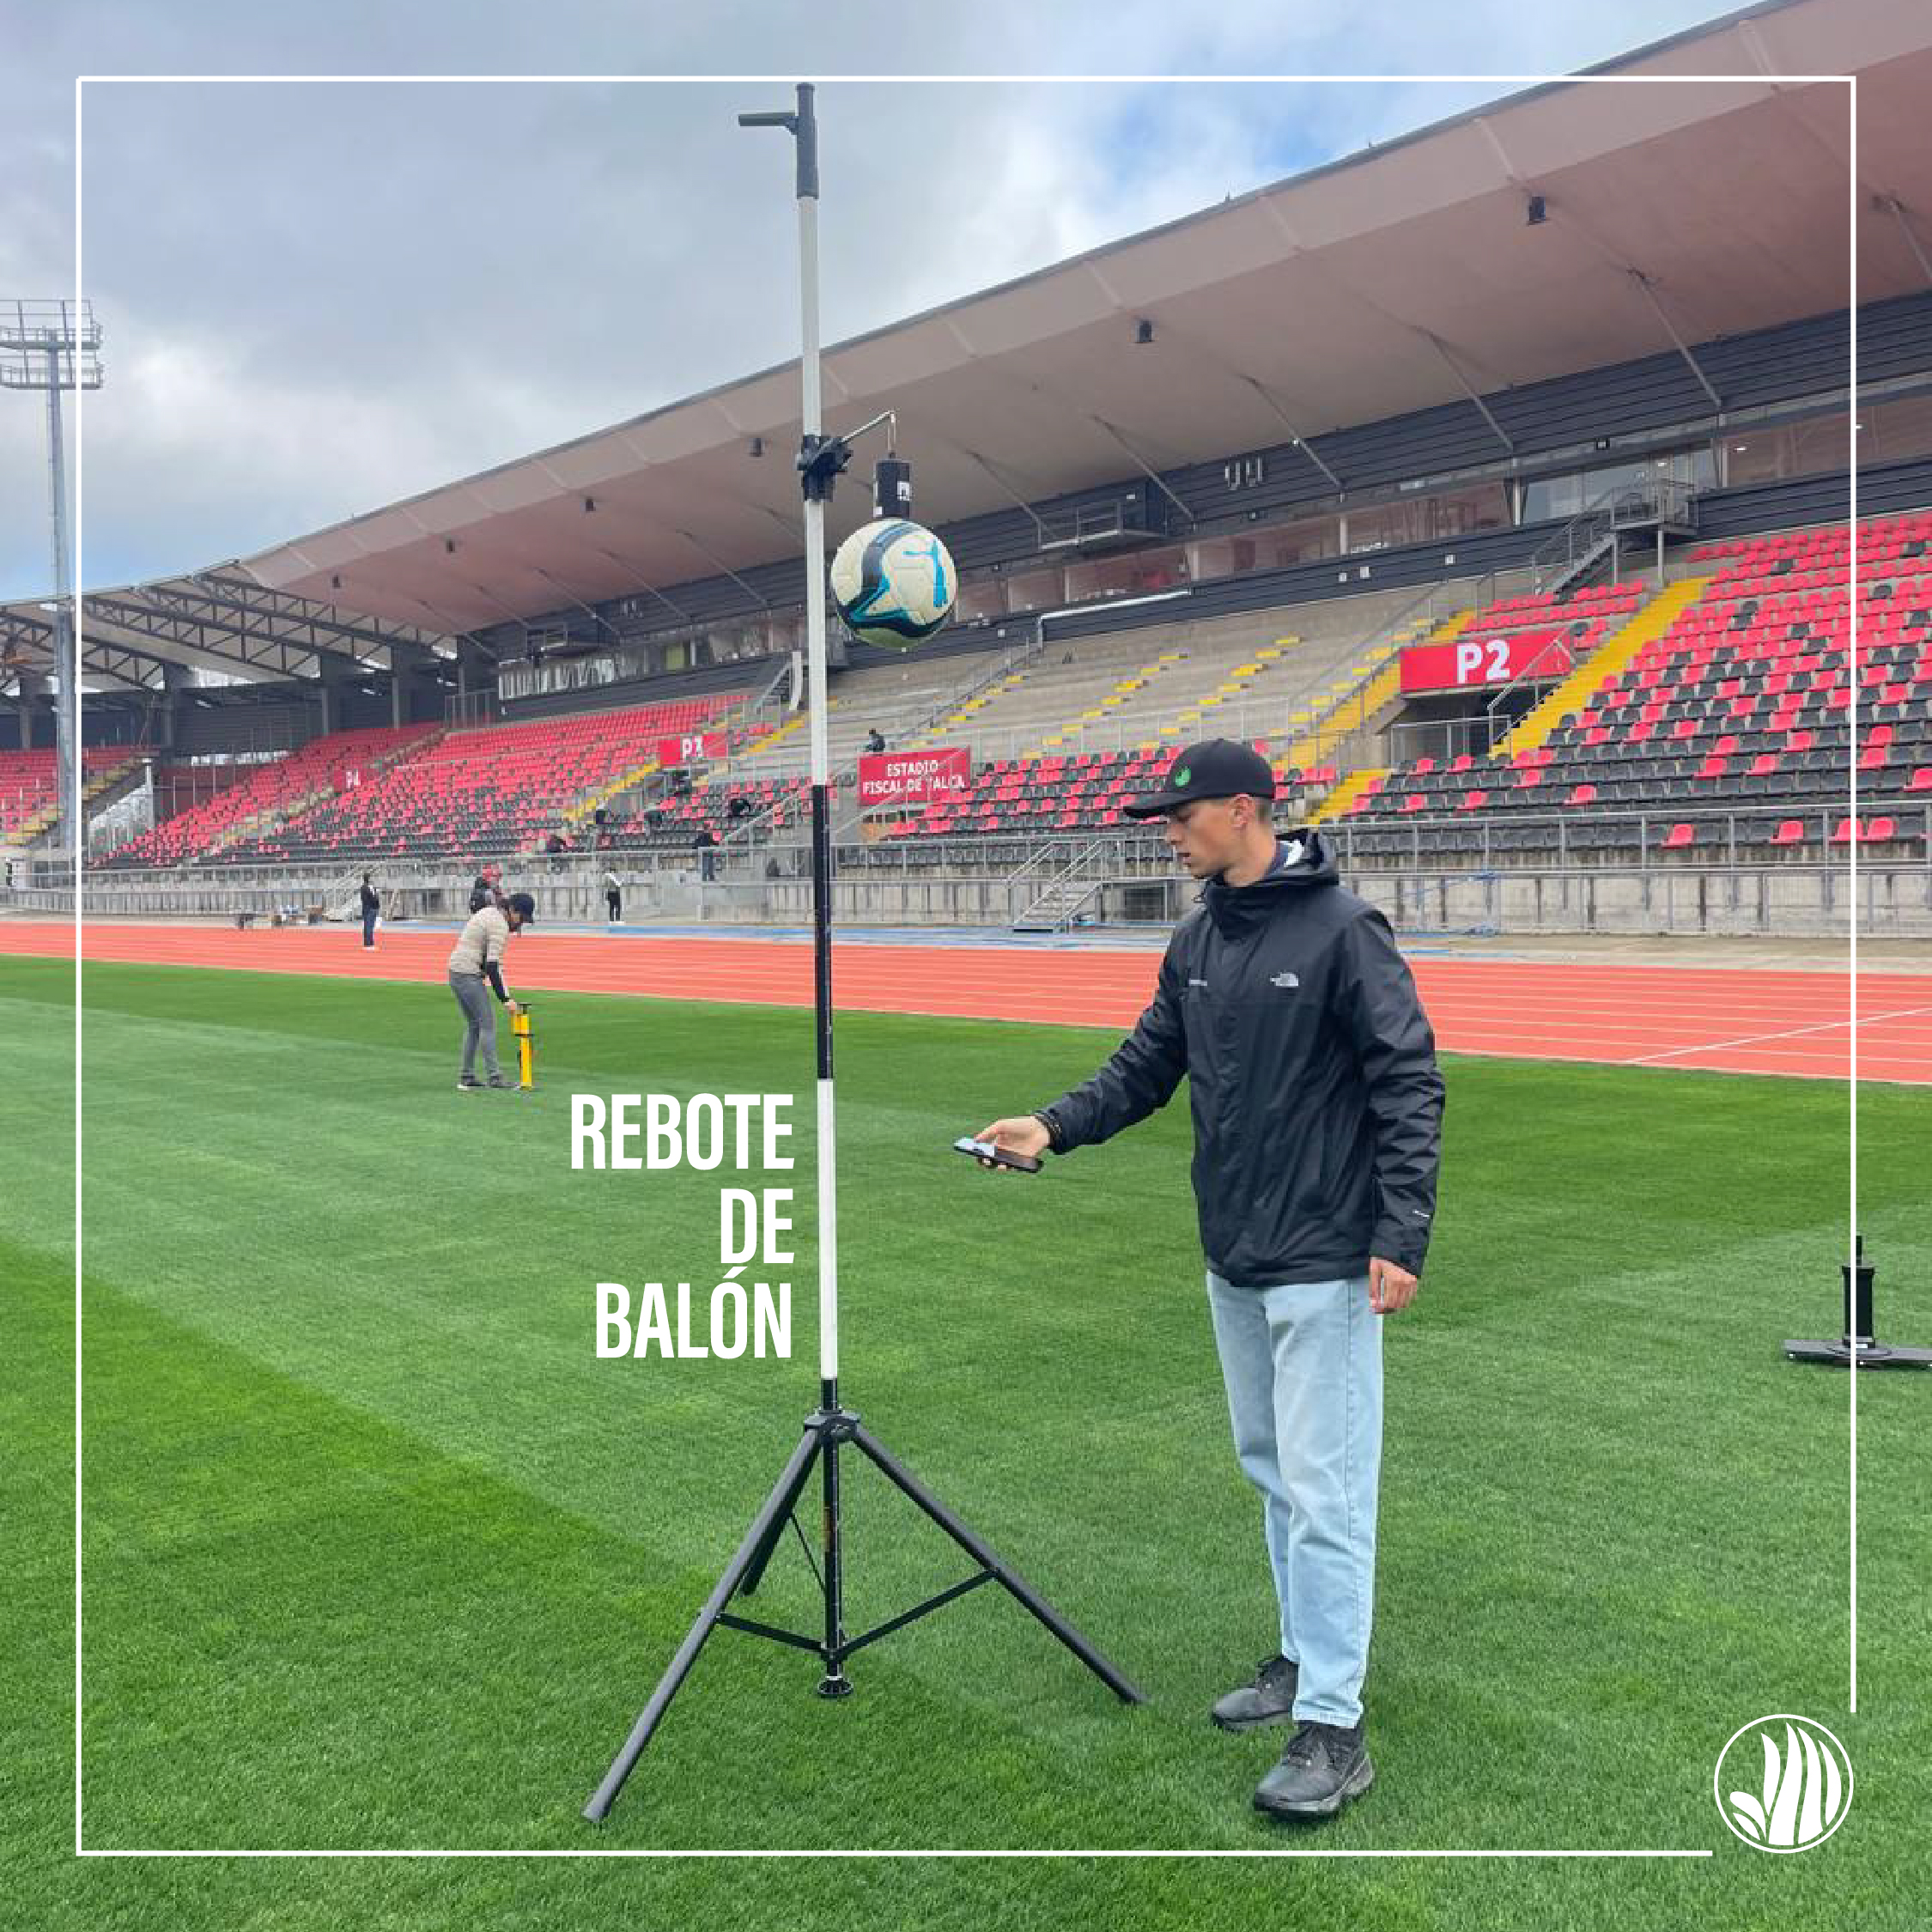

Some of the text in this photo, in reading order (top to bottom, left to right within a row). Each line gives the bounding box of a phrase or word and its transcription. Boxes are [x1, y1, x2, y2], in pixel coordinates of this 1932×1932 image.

[1457, 640, 1510, 683] P2
[887, 760, 939, 777] ESTADIO
[862, 780, 902, 795] FISCAL
[907, 778, 922, 792] DE
